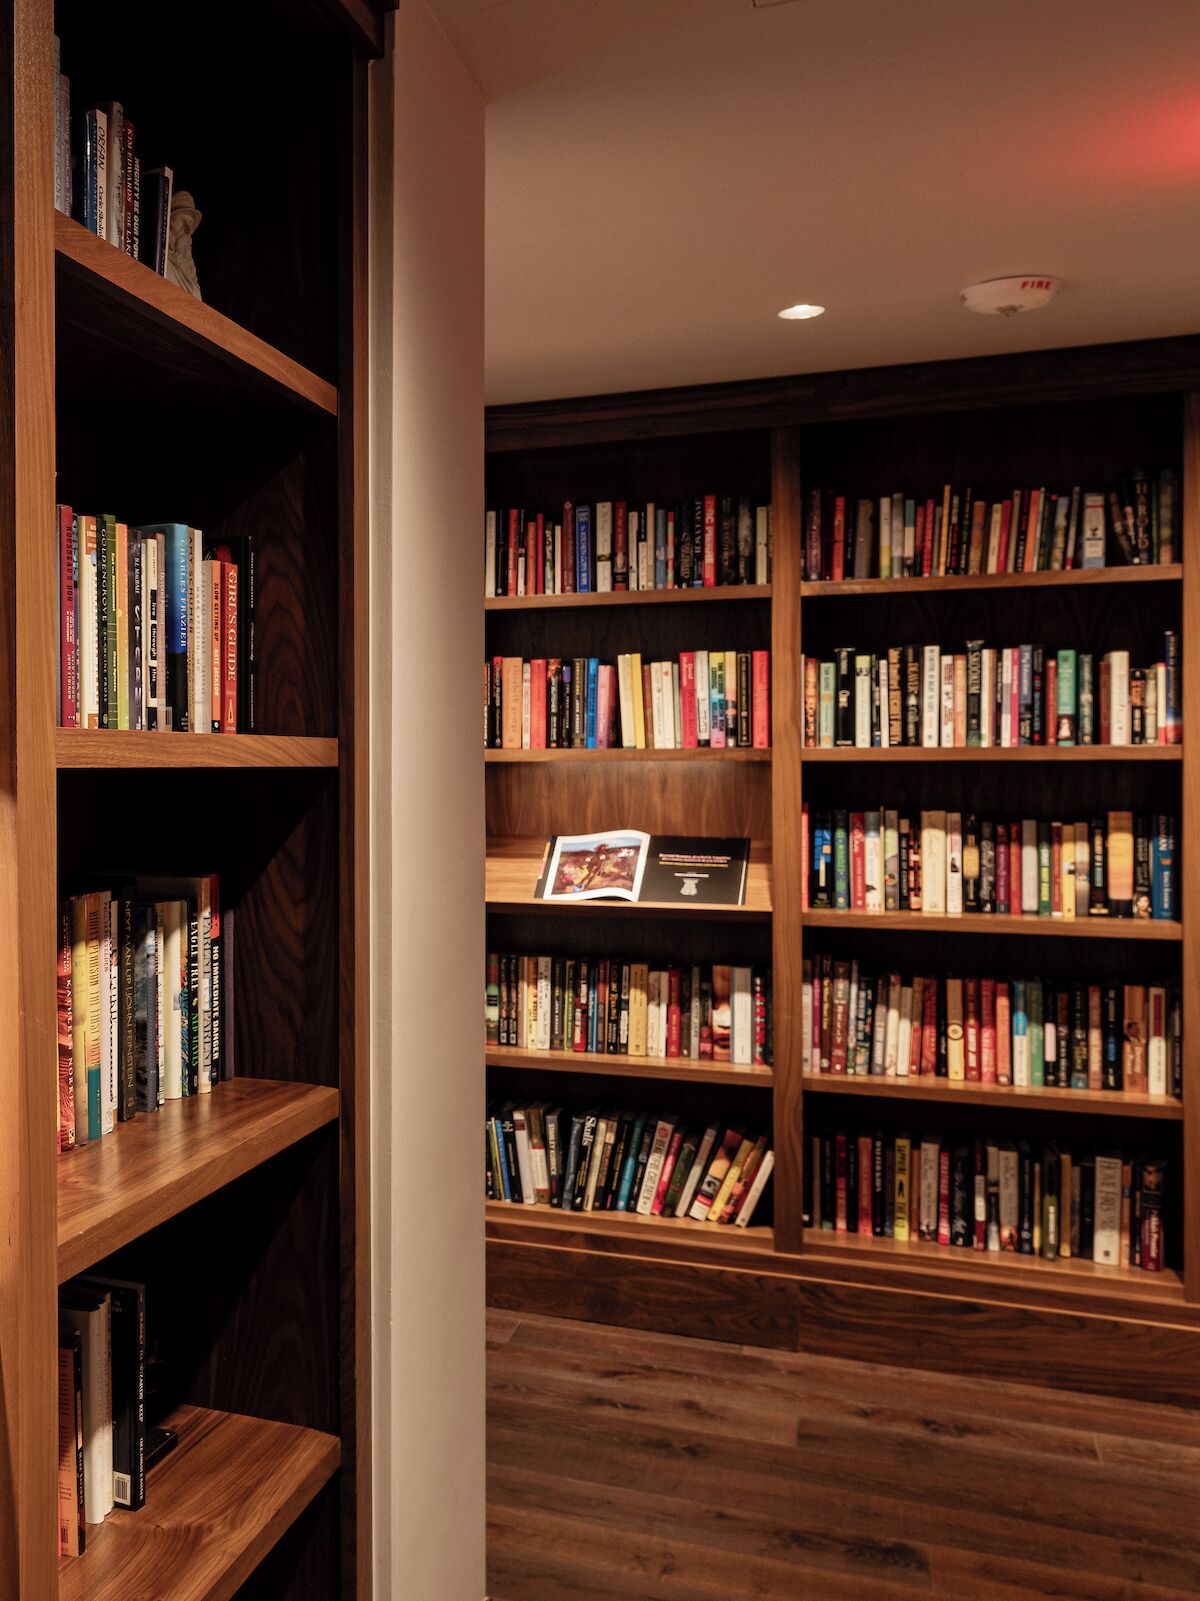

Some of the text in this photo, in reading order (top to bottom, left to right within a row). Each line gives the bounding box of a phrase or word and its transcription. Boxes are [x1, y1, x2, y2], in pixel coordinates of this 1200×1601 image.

[97, 126, 105, 171] ORFAN
[133, 201, 140, 214] BE
[180, 598, 188, 647] FRAZIER
[227, 631, 237, 681] GUIDE
[123, 900, 133, 984] NEXT MAN UP
[190, 921, 198, 991] EAGLE TREE
[212, 946, 219, 958] NO
[125, 989, 134, 1088] JOHN FEINSTEIN
